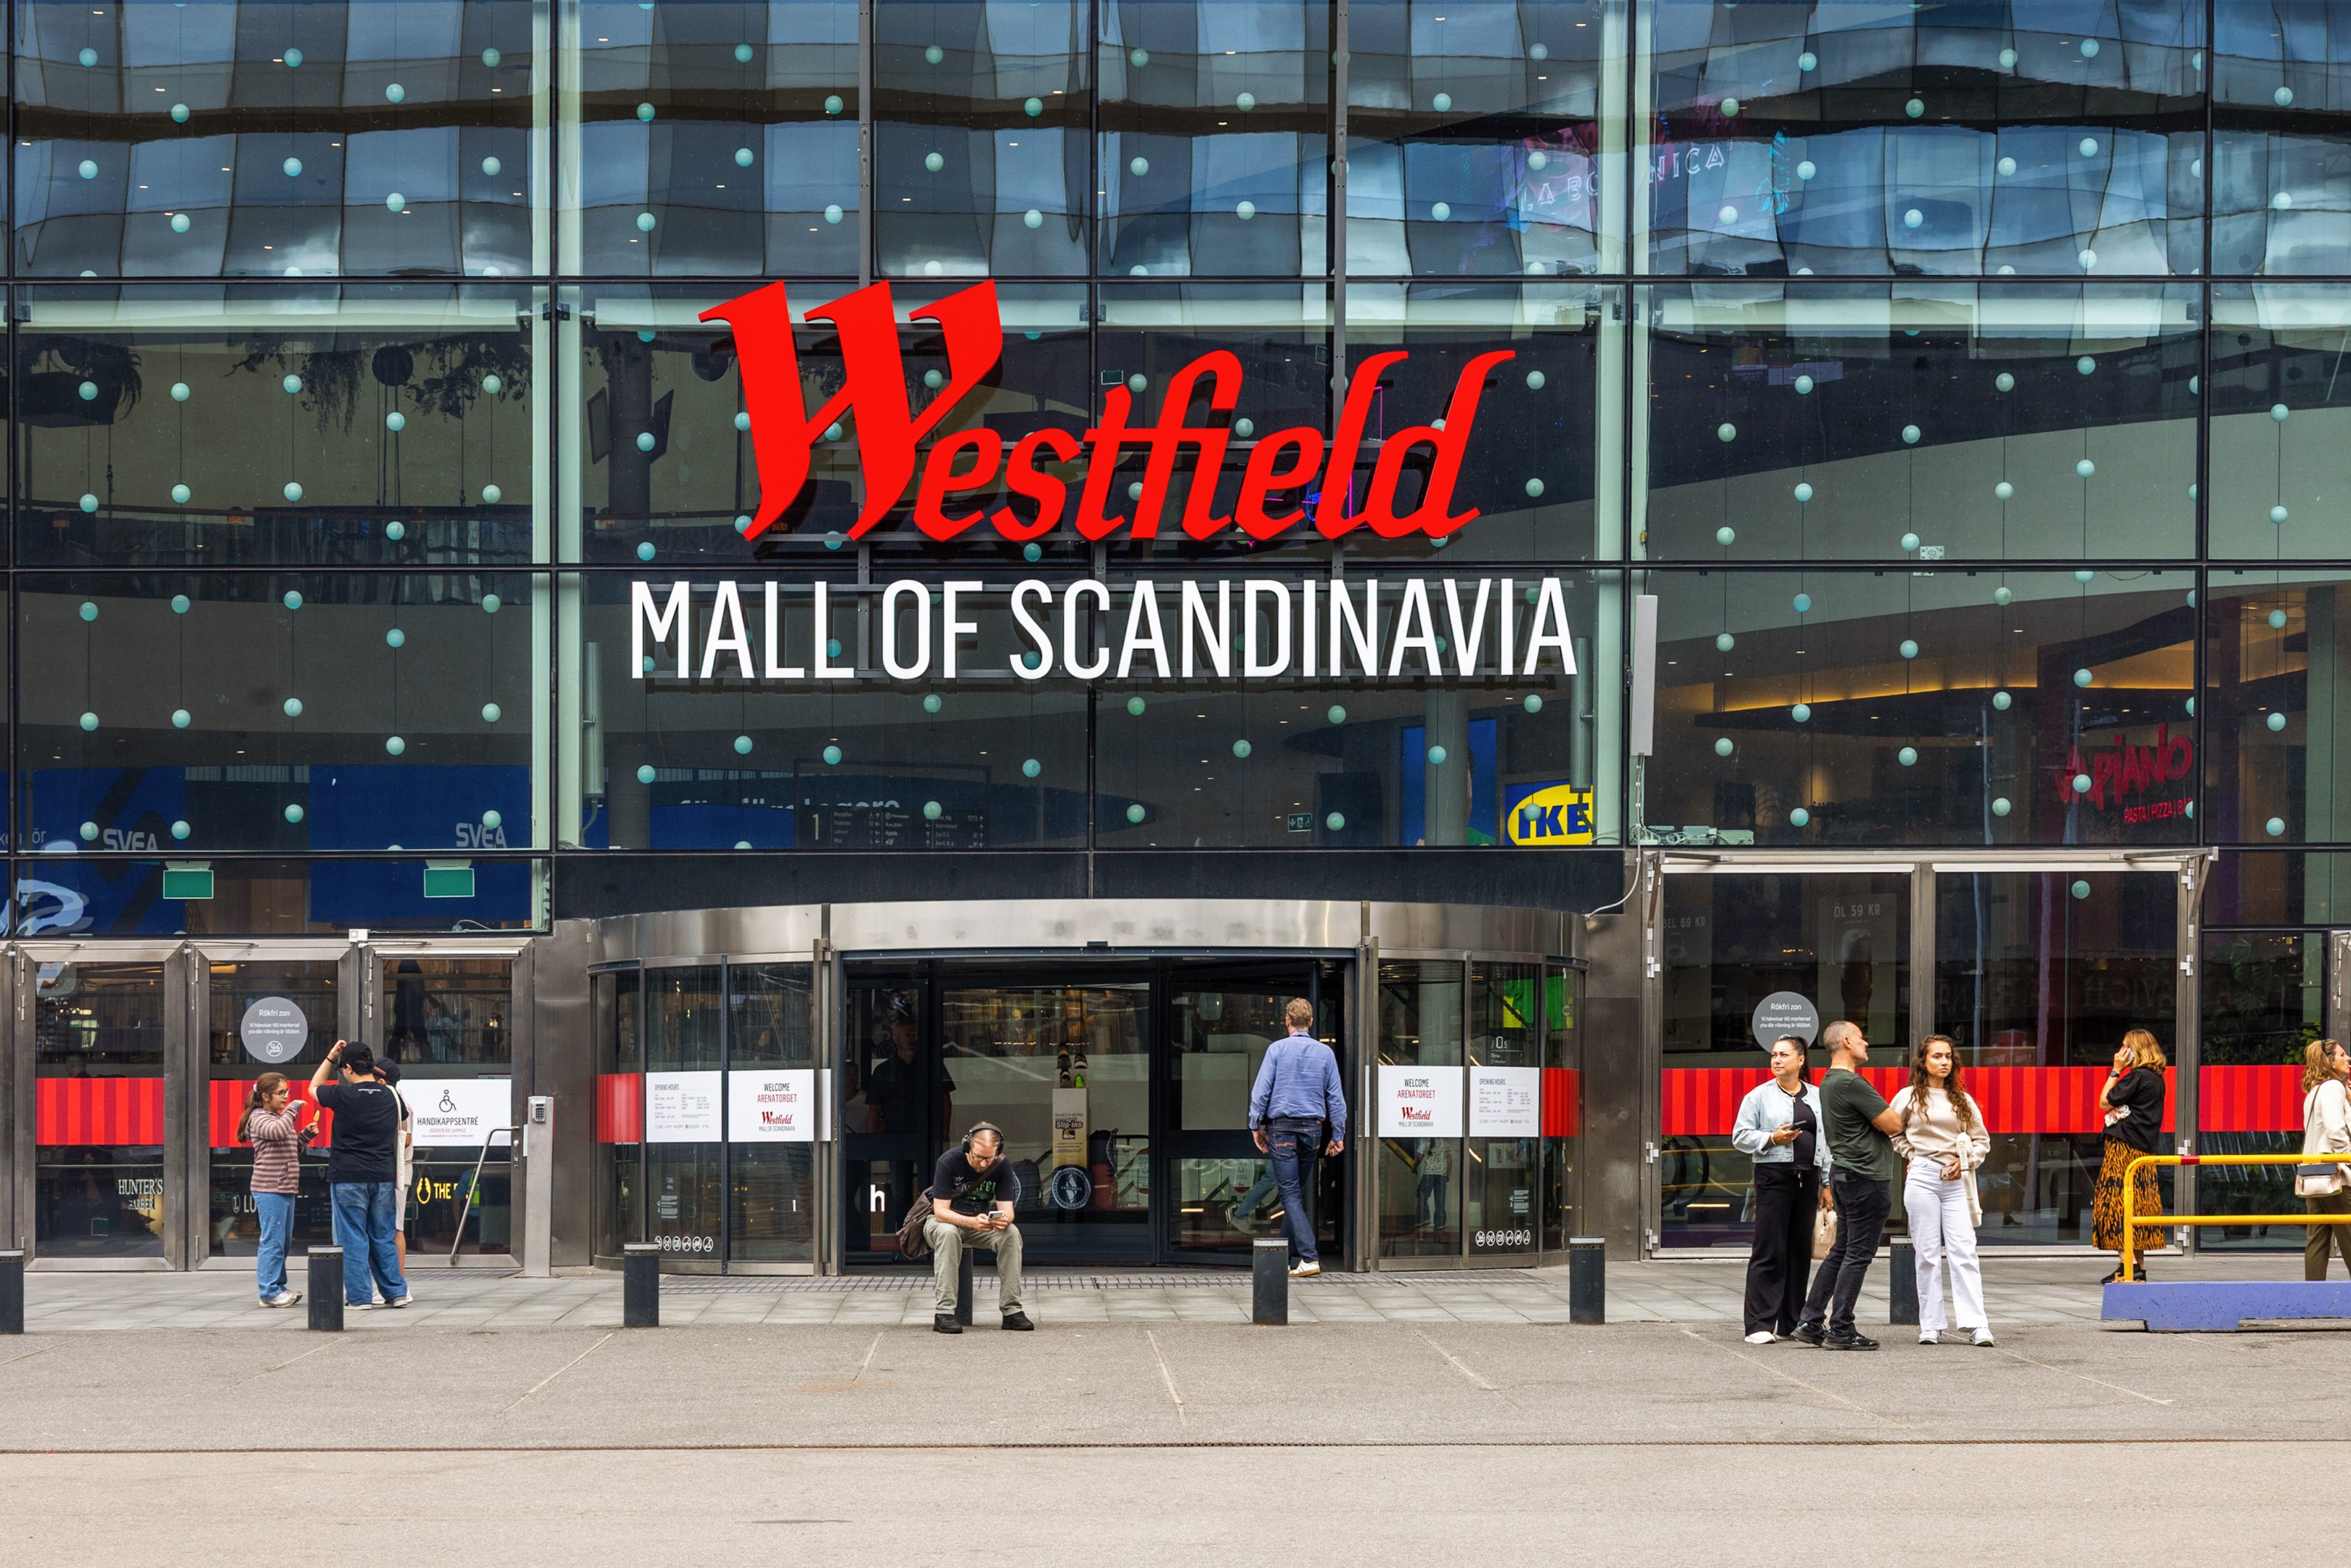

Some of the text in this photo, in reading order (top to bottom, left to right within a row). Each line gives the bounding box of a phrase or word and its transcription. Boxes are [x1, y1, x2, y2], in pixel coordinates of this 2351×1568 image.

[700, 279, 1516, 542] Westfield
[632, 576, 1578, 680] MALL OF SCANDINAVIA
[2124, 807, 2147, 824] PASTA
[2151, 801, 2173, 819] PIZZA
[1518, 803, 1590, 839] IKE
[103, 828, 158, 851] SVEA
[455, 822, 508, 849] SVEA
[1851, 905, 1863, 917] 59
[1868, 904, 1881, 915] KR
[1680, 918, 1691, 928] 69
[1695, 916, 1706, 927] KR
[764, 1082, 790, 1092] WELCOME
[1404, 1079, 1429, 1087] WELCOME
[757, 1094, 797, 1103] ARENATORGET
[1397, 1090, 1435, 1098] ARENATORGET
[762, 1111, 793, 1124] Westfield
[1401, 1106, 1431, 1119] Westfield
[417, 1116, 478, 1125] HANDIKAPPSENTRÉ
[1056, 1120, 1083, 1129] Slip-ins
[118, 1179, 163, 1195] HUNTER'S
[433, 1183, 452, 1199] THE
